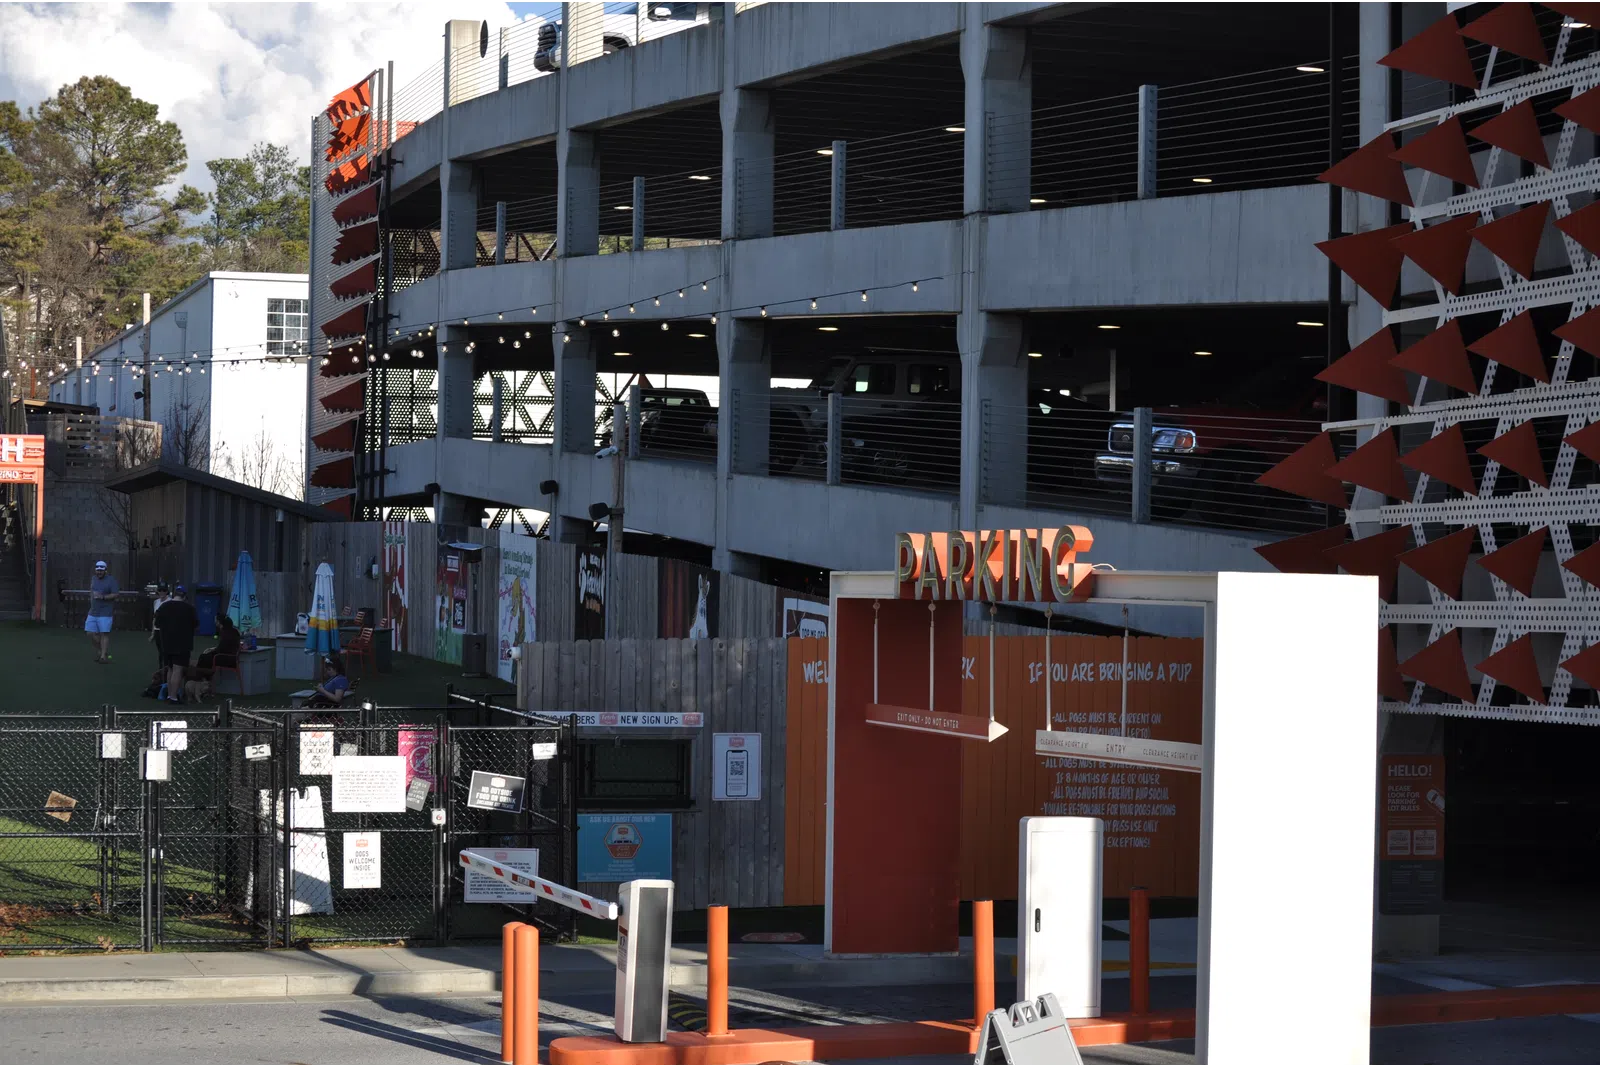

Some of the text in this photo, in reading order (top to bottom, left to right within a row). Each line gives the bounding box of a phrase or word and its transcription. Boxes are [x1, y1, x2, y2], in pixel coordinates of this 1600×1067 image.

[2, 437, 24, 462] H
[894, 525, 1093, 603] PARKING
[1029, 662, 1043, 684] IF
[1071, 662, 1094, 682] ARE
[1099, 661, 1153, 683] BRINGING
[1156, 663, 1166, 682] A
[1168, 662, 1192, 683] PUP
[620, 716, 638, 724] NEW
[642, 716, 660, 724] SIGN
[897, 712, 908, 722] EXIT
[908, 714, 920, 724] ONLY
[924, 716, 932, 725] DO
[932, 717, 942, 726] NOT
[943, 718, 960, 729] ENTER
[1108, 712, 1117, 724] BE
[1106, 743, 1127, 754] ENTRY
[1388, 764, 1432, 777] HELLO!
[1111, 773, 1126, 785] AGE
